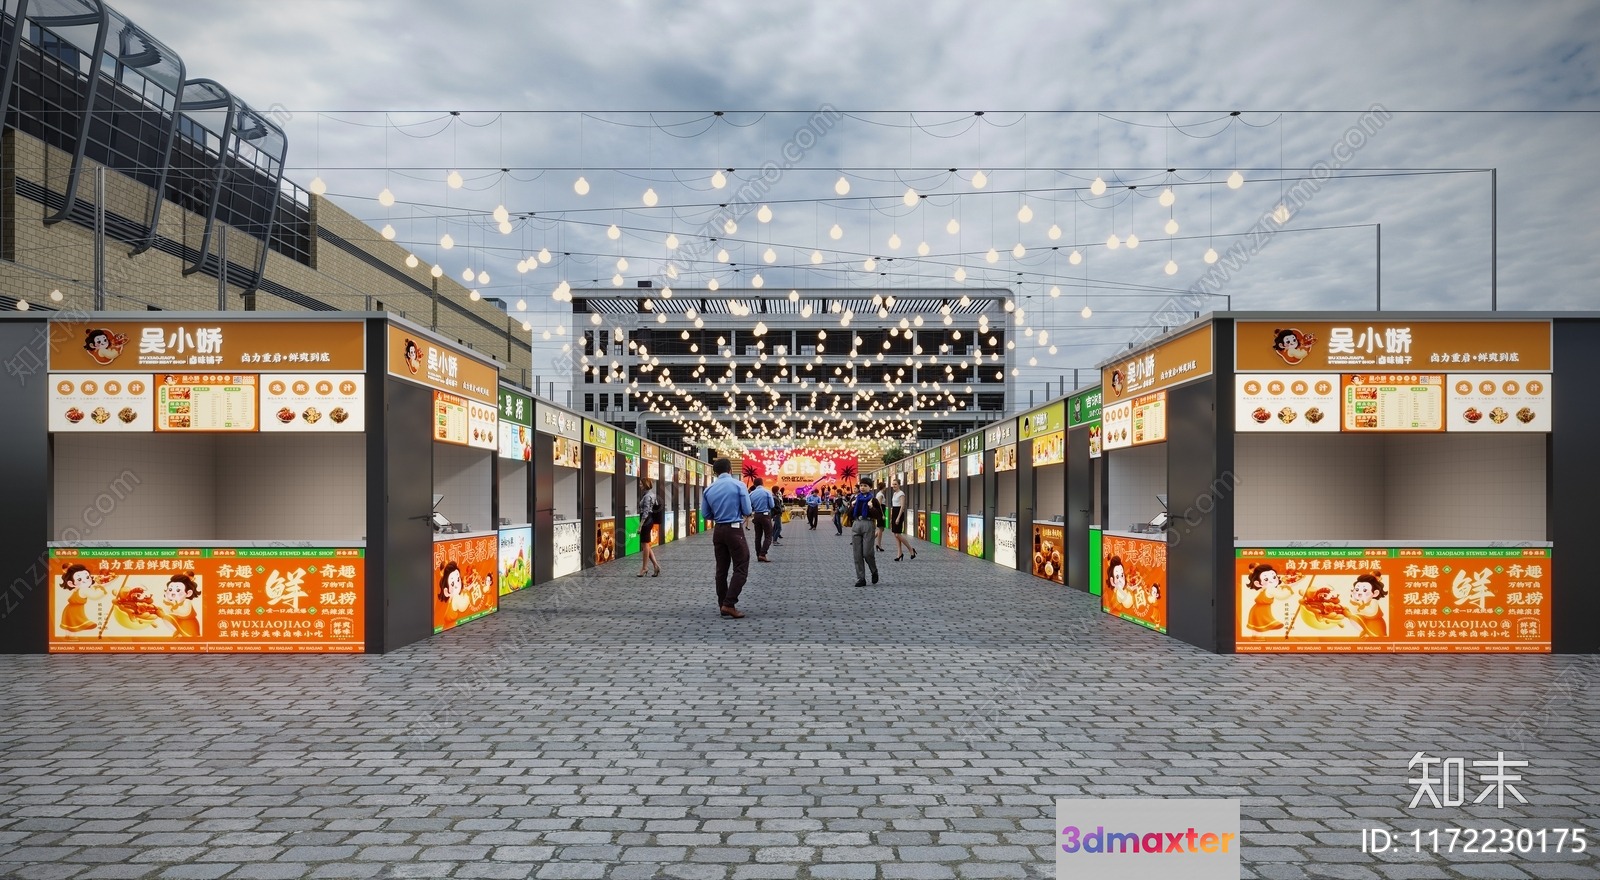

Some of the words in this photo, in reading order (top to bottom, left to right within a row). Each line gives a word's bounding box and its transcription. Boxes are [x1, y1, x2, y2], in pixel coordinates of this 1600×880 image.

[139, 326, 223, 354] 吴小娇
[1328, 326, 1412, 354] 吴小娇
[188, 356, 223, 365] 卤味铺子
[428, 346, 458, 378] 吴小娇
[1378, 356, 1412, 365] 卤味铺子
[1127, 354, 1155, 384] 吴小娇
[558, 543, 577, 555] CHAGEE
[99, 560, 195, 570] 卤力重启鲜爽到底
[216, 564, 253, 578] 奇趣
[320, 564, 357, 578] 奇趣
[1286, 560, 1382, 570] 卤力重启鲜爽到底
[1403, 564, 1440, 578] 奇趣
[1507, 564, 1544, 578] 奇趣
[265, 568, 308, 613] 鲜
[1452, 568, 1495, 613] 鲜
[217, 592, 253, 605] 现捞
[320, 592, 357, 605] 现捞
[1404, 592, 1440, 605] 现捞
[1507, 592, 1544, 605] 现捞
[231, 620, 311, 629] WUXIAOJIAO
[1418, 620, 1498, 629] WUXIAOJIAO
[219, 630, 323, 638] 正宗长沙美味卤味小吃
[1406, 630, 1510, 638] 正宗长沙美味卤味小吃
